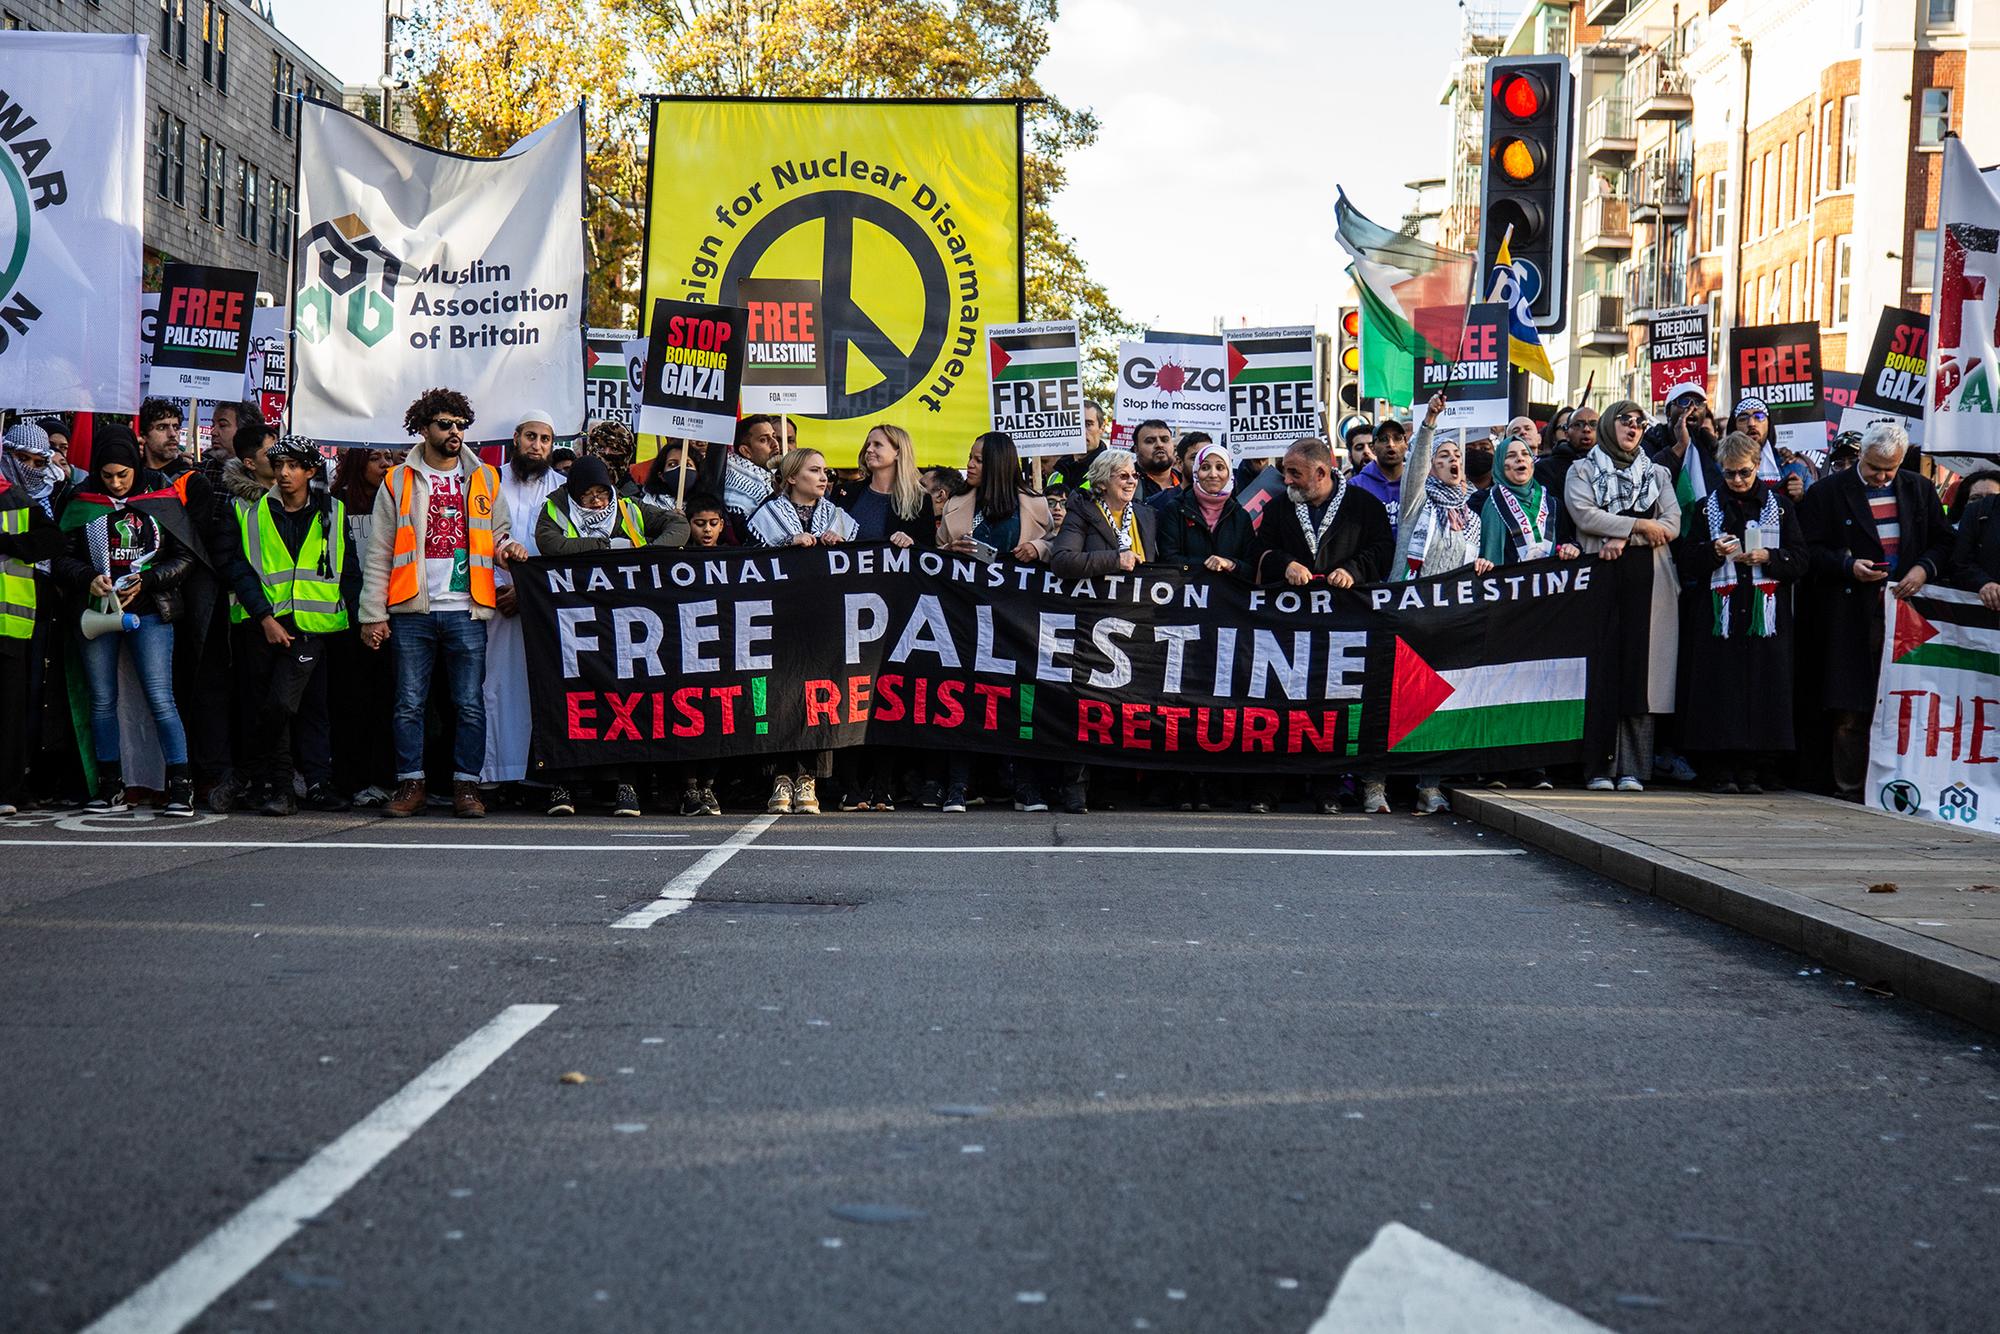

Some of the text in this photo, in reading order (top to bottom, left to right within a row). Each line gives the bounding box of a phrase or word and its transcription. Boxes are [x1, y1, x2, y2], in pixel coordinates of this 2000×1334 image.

[0, 89, 68, 212] WAR
[415, 259, 511, 288] Muslim
[715, 182, 764, 229] for
[771, 151, 908, 192] Nuclear
[910, 183, 980, 414] Disarmament
[1937, 222, 2000, 350] F
[168, 286, 245, 331] FREE
[409, 288, 569, 317] Association
[667, 315, 732, 353] STOP
[747, 301, 815, 342] FREE
[989, 324, 1076, 336] Palestine Solidarity Campaign
[1226, 328, 1312, 340] Palestine Solidarity Campaign
[1655, 318, 1703, 338] FREEDOM
[164, 325, 241, 350] PALESTINE
[409, 321, 540, 349] of Britain
[1675, 334, 1684, 342] for
[665, 345, 728, 371] BOMBING
[747, 343, 817, 363] PALESTINE
[1653, 339, 1706, 360] PALESTINE
[1423, 360, 1498, 384] PALESTINE
[1662, 361, 1697, 379] الحرية
[1739, 343, 1813, 387] FREE
[179, 374, 192, 385] FOA
[660, 362, 725, 402] GAZA
[1934, 355, 2000, 414] PA
[769, 393, 781, 402] FOA
[993, 378, 1080, 416] FREE
[1122, 397, 1227, 412] Stop the massacre
[1229, 382, 1315, 417] FREE
[1740, 381, 1814, 404] PALESTINE
[672, 415, 685, 427] FOA
[994, 411, 1081, 431] PALESTINE
[1230, 414, 1315, 432] PALESTINE
[1443, 407, 1457, 417] FOA
[1011, 431, 1039, 440] ISRAELI
[1039, 428, 1081, 438] OCCUPATION
[1231, 430, 1314, 442] END ISRAELI OCCUPATION
[547, 547, 1592, 614] NATIONAL DEMONSTRATION FOR PALESTINE
[556, 592, 1368, 700] FREE PALESTINE
[565, 674, 1364, 757] EXIST! RESIST! RETURN!
[1888, 689, 2000, 765] THE
